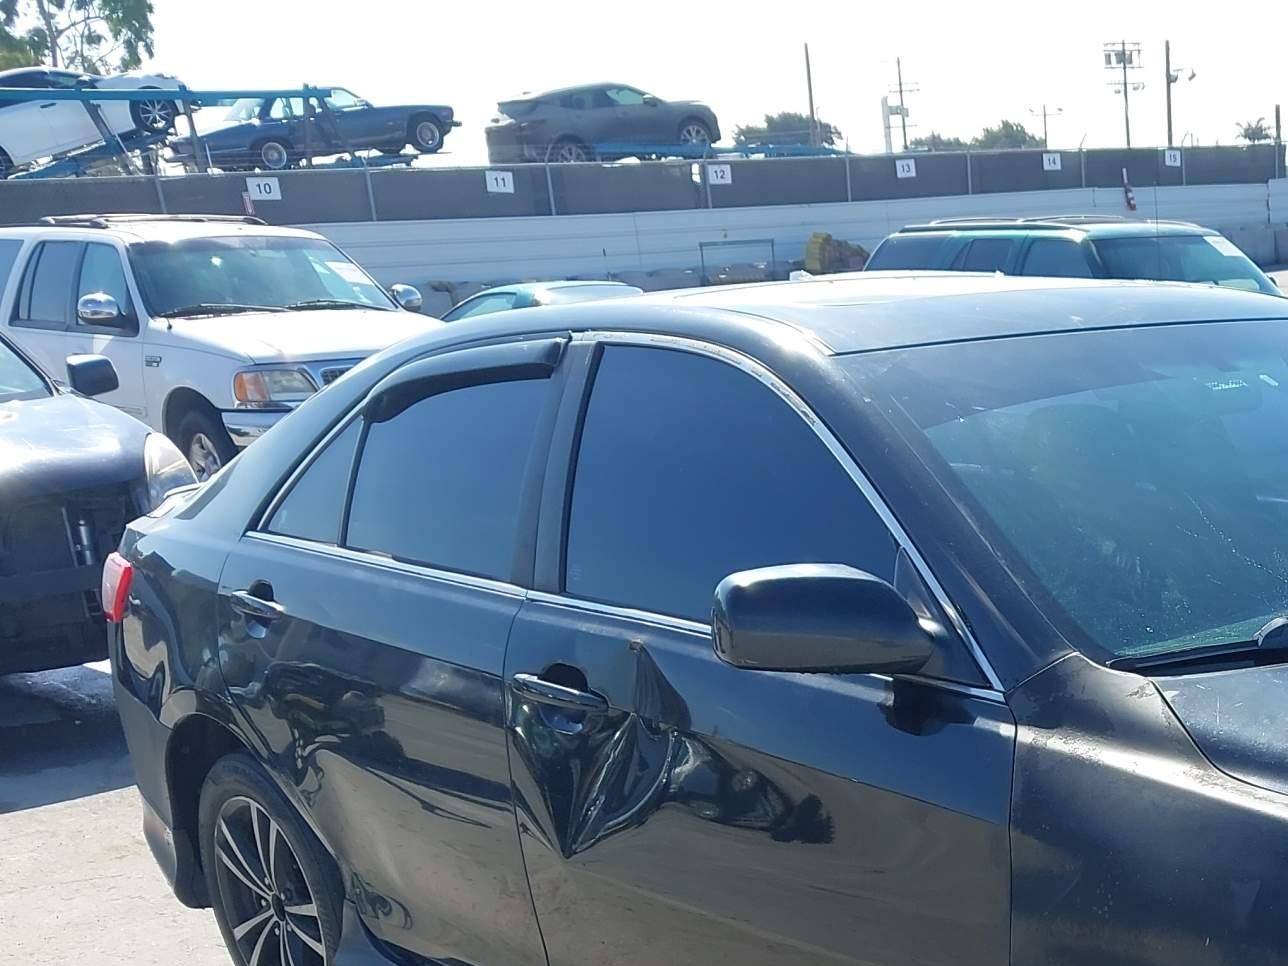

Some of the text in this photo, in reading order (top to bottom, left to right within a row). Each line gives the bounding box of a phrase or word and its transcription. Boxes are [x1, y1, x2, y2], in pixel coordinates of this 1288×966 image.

[1047, 157, 1057, 166] 14
[1169, 153, 1178, 163] 15
[901, 163, 911, 174] 13
[713, 169, 726, 179] 12
[494, 176, 507, 187] 11
[255, 182, 272, 195] 10
